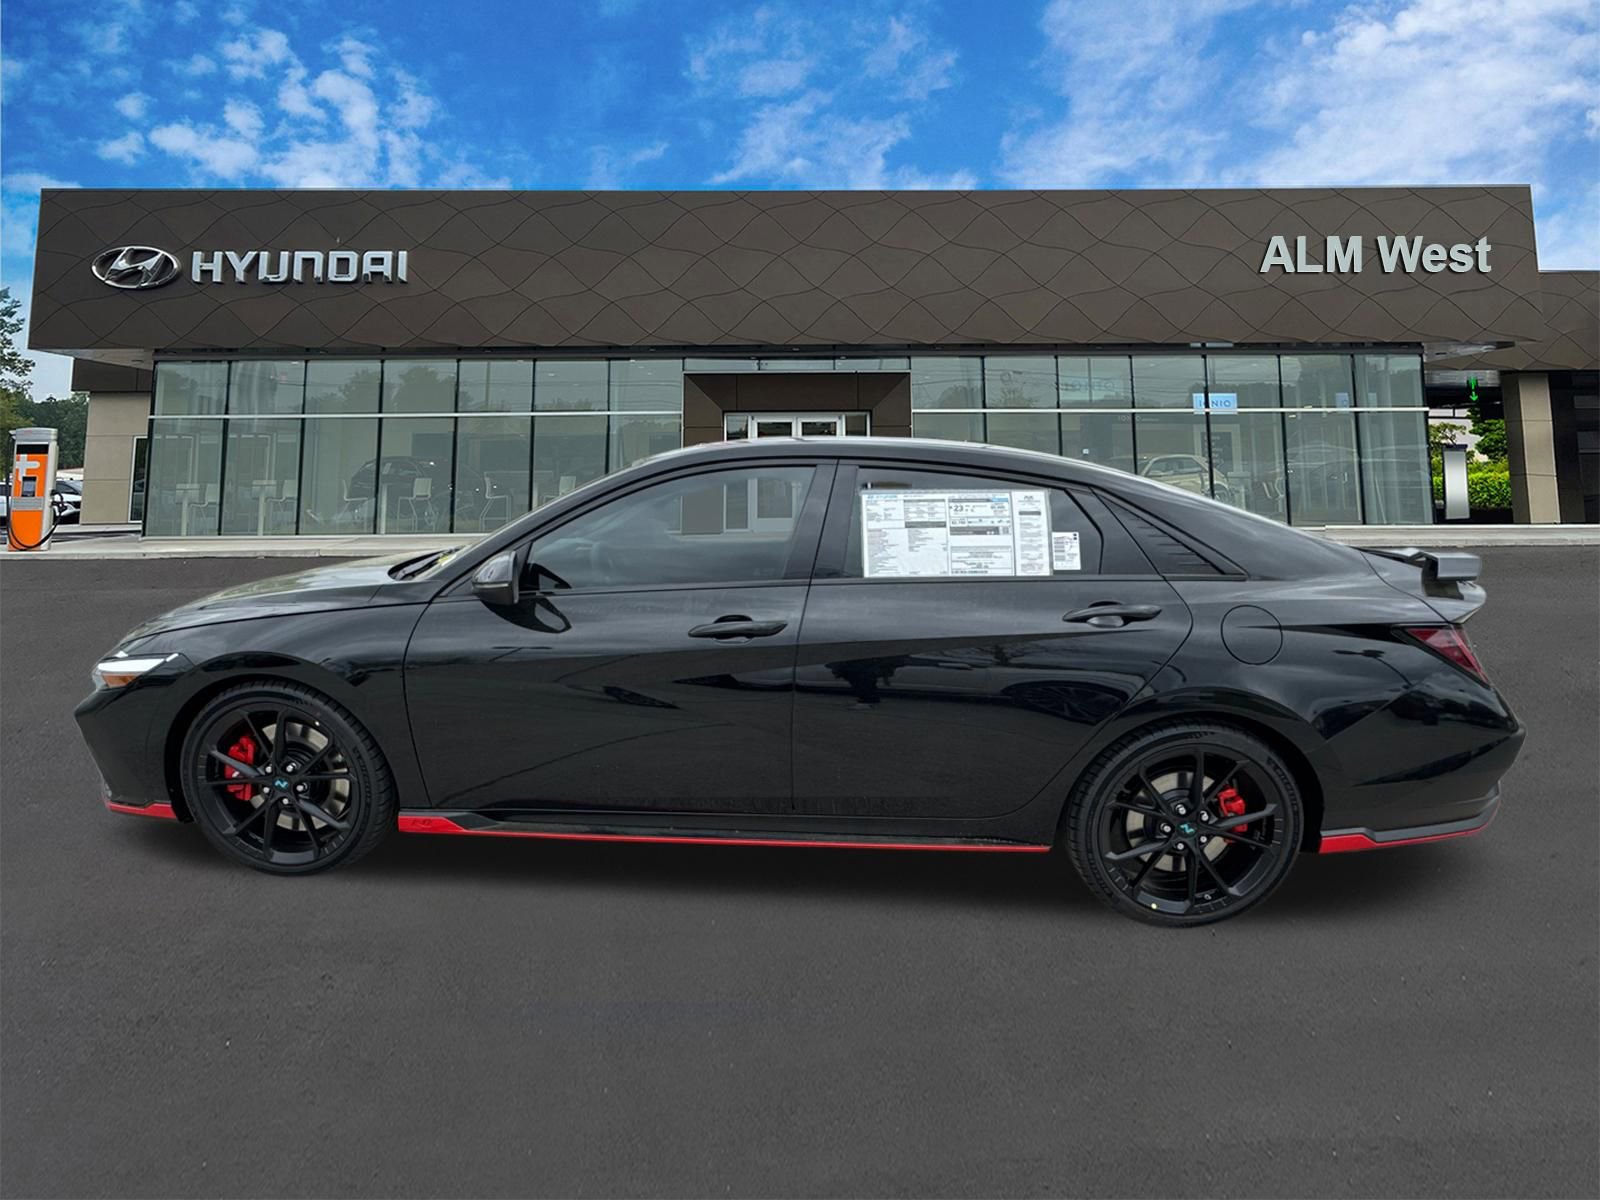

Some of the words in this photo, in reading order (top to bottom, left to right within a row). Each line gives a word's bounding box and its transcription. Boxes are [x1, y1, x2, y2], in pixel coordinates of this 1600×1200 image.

[191, 250, 408, 283] HYUNDAI
[1259, 235, 1363, 273] ALM
[1376, 235, 1492, 273] West
